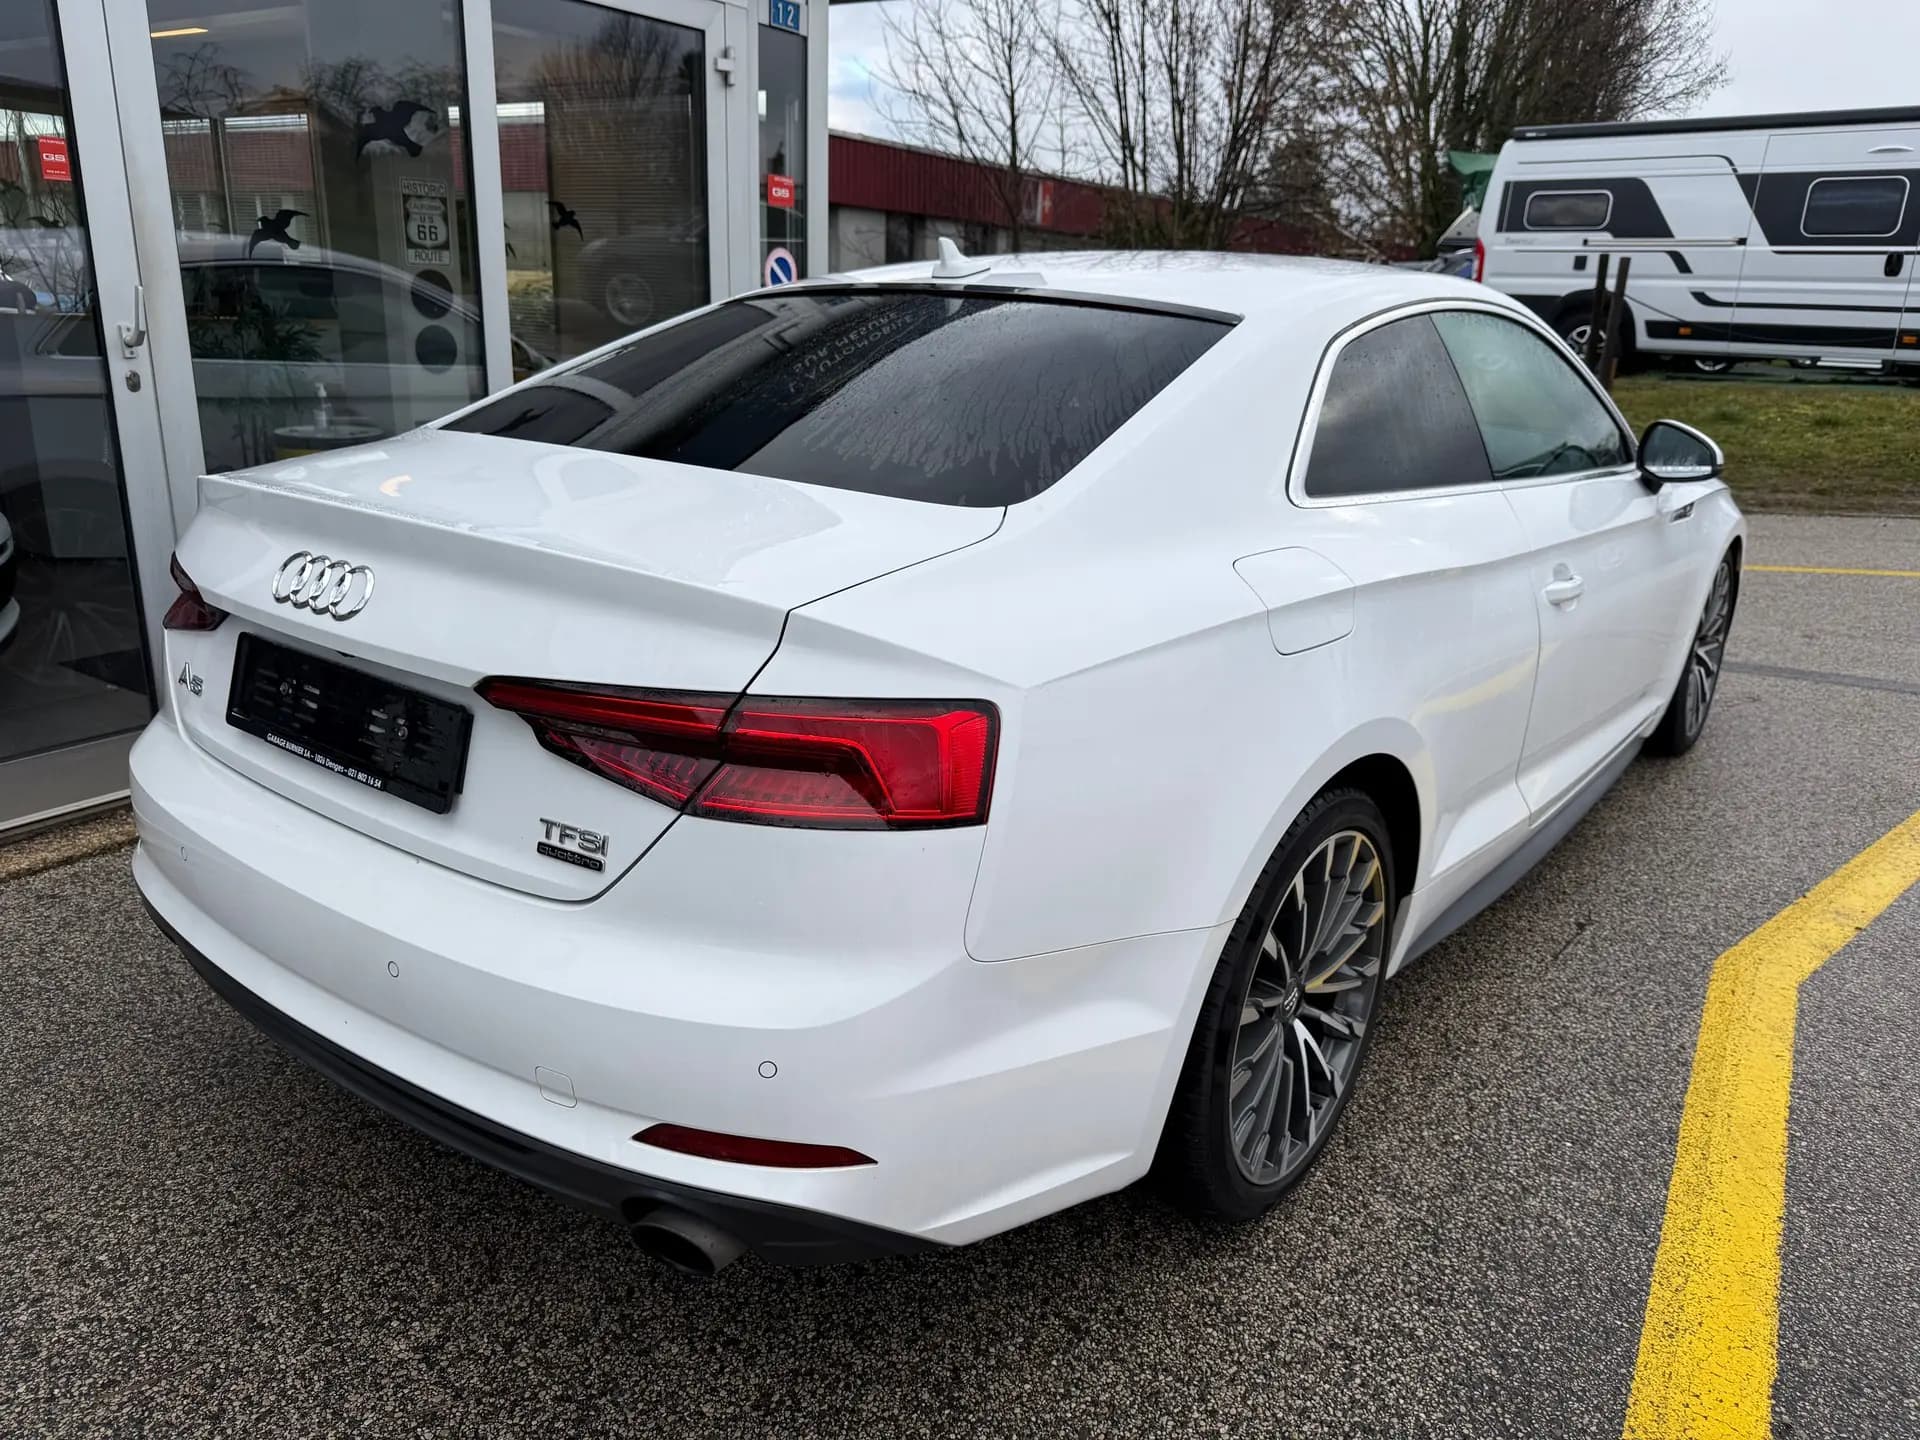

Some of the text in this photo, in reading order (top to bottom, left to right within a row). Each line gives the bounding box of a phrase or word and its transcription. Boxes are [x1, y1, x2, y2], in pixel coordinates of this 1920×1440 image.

[777, 3, 794, 27] 12
[403, 182, 447, 194] HISTORIC
[417, 224, 438, 241] 66
[415, 250, 444, 262] ROUTE
[178, 661, 203, 697] A5
[266, 732, 286, 748] GARAGE
[325, 758, 344, 773] Denges
[539, 817, 609, 858] TFSI
[538, 844, 600, 869] quattro
